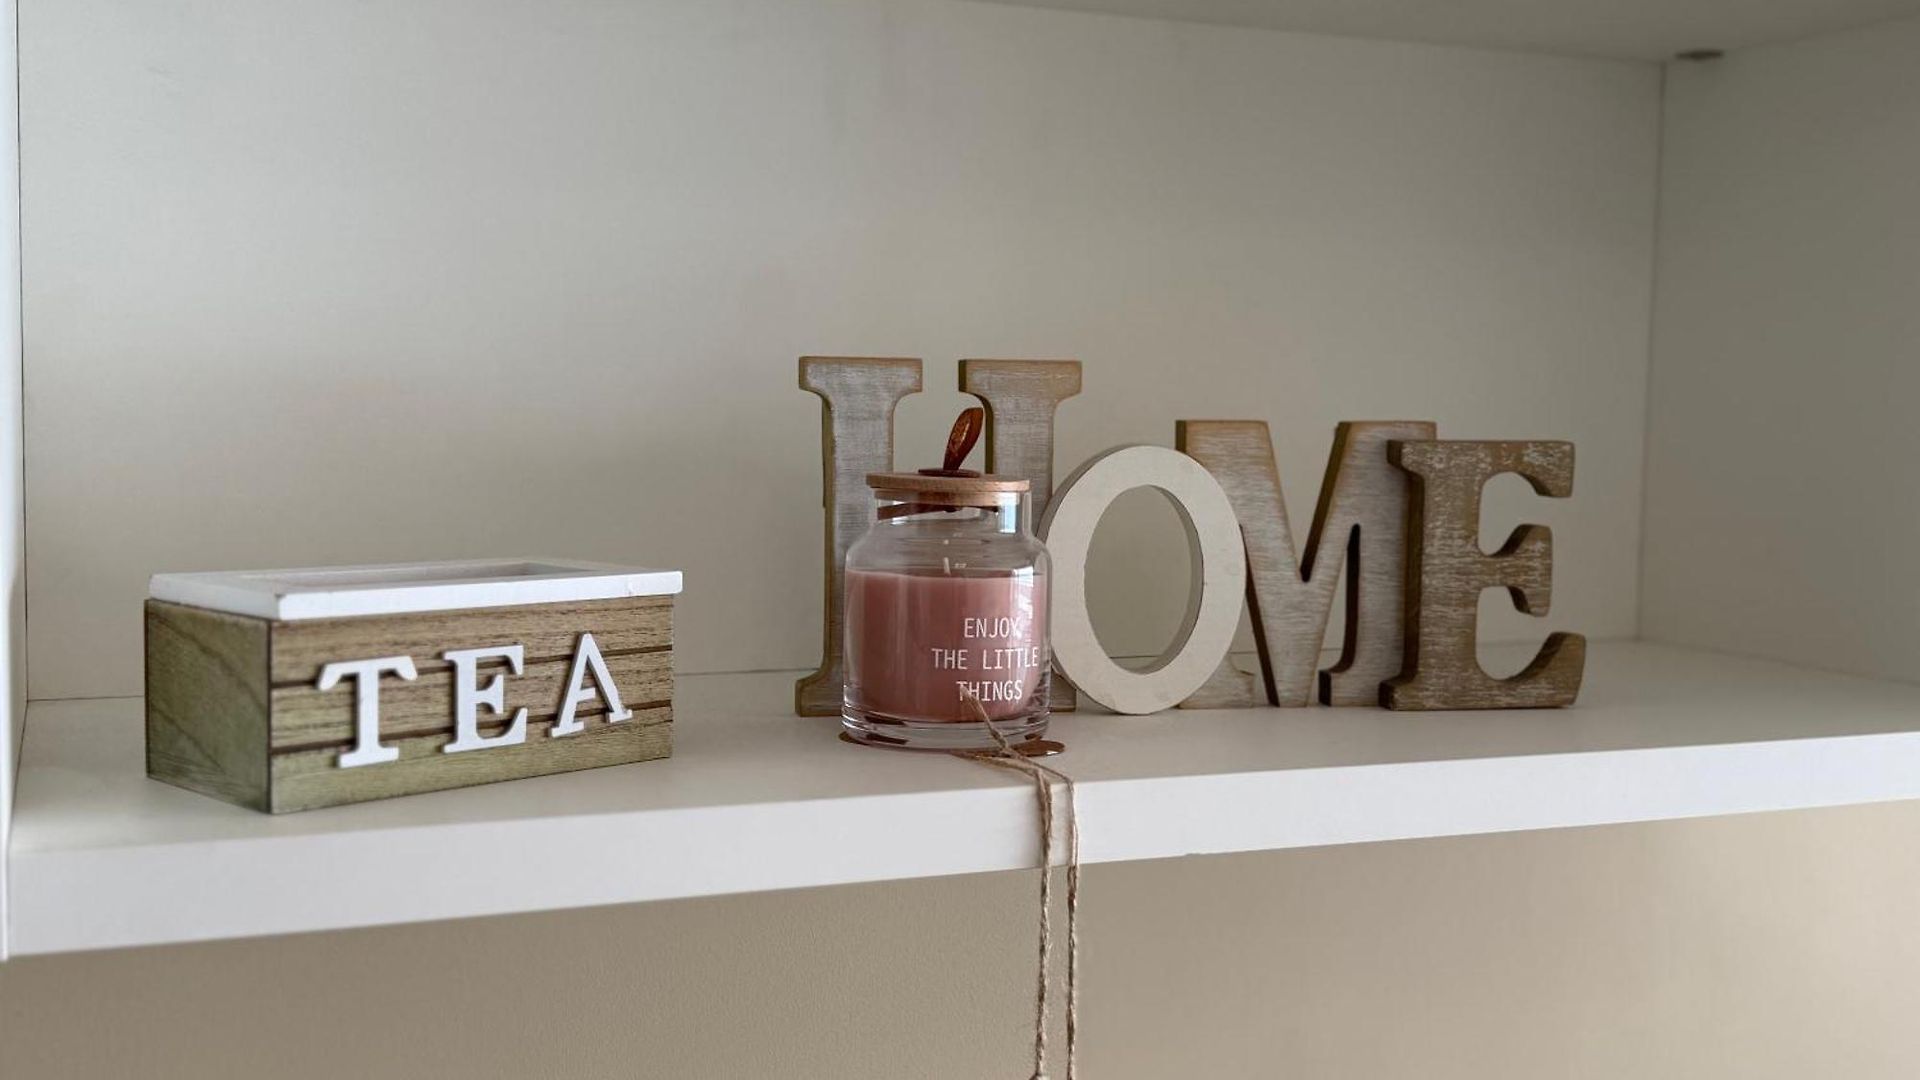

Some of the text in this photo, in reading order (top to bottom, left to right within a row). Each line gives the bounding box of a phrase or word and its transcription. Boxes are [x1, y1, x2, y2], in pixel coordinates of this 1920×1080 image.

[795, 356, 1587, 717] HOME
[964, 617, 1021, 638] ENJOY
[932, 647, 1038, 669] THE LITTLE
[317, 632, 633, 768] TEA
[957, 680, 1023, 701] THINGS
